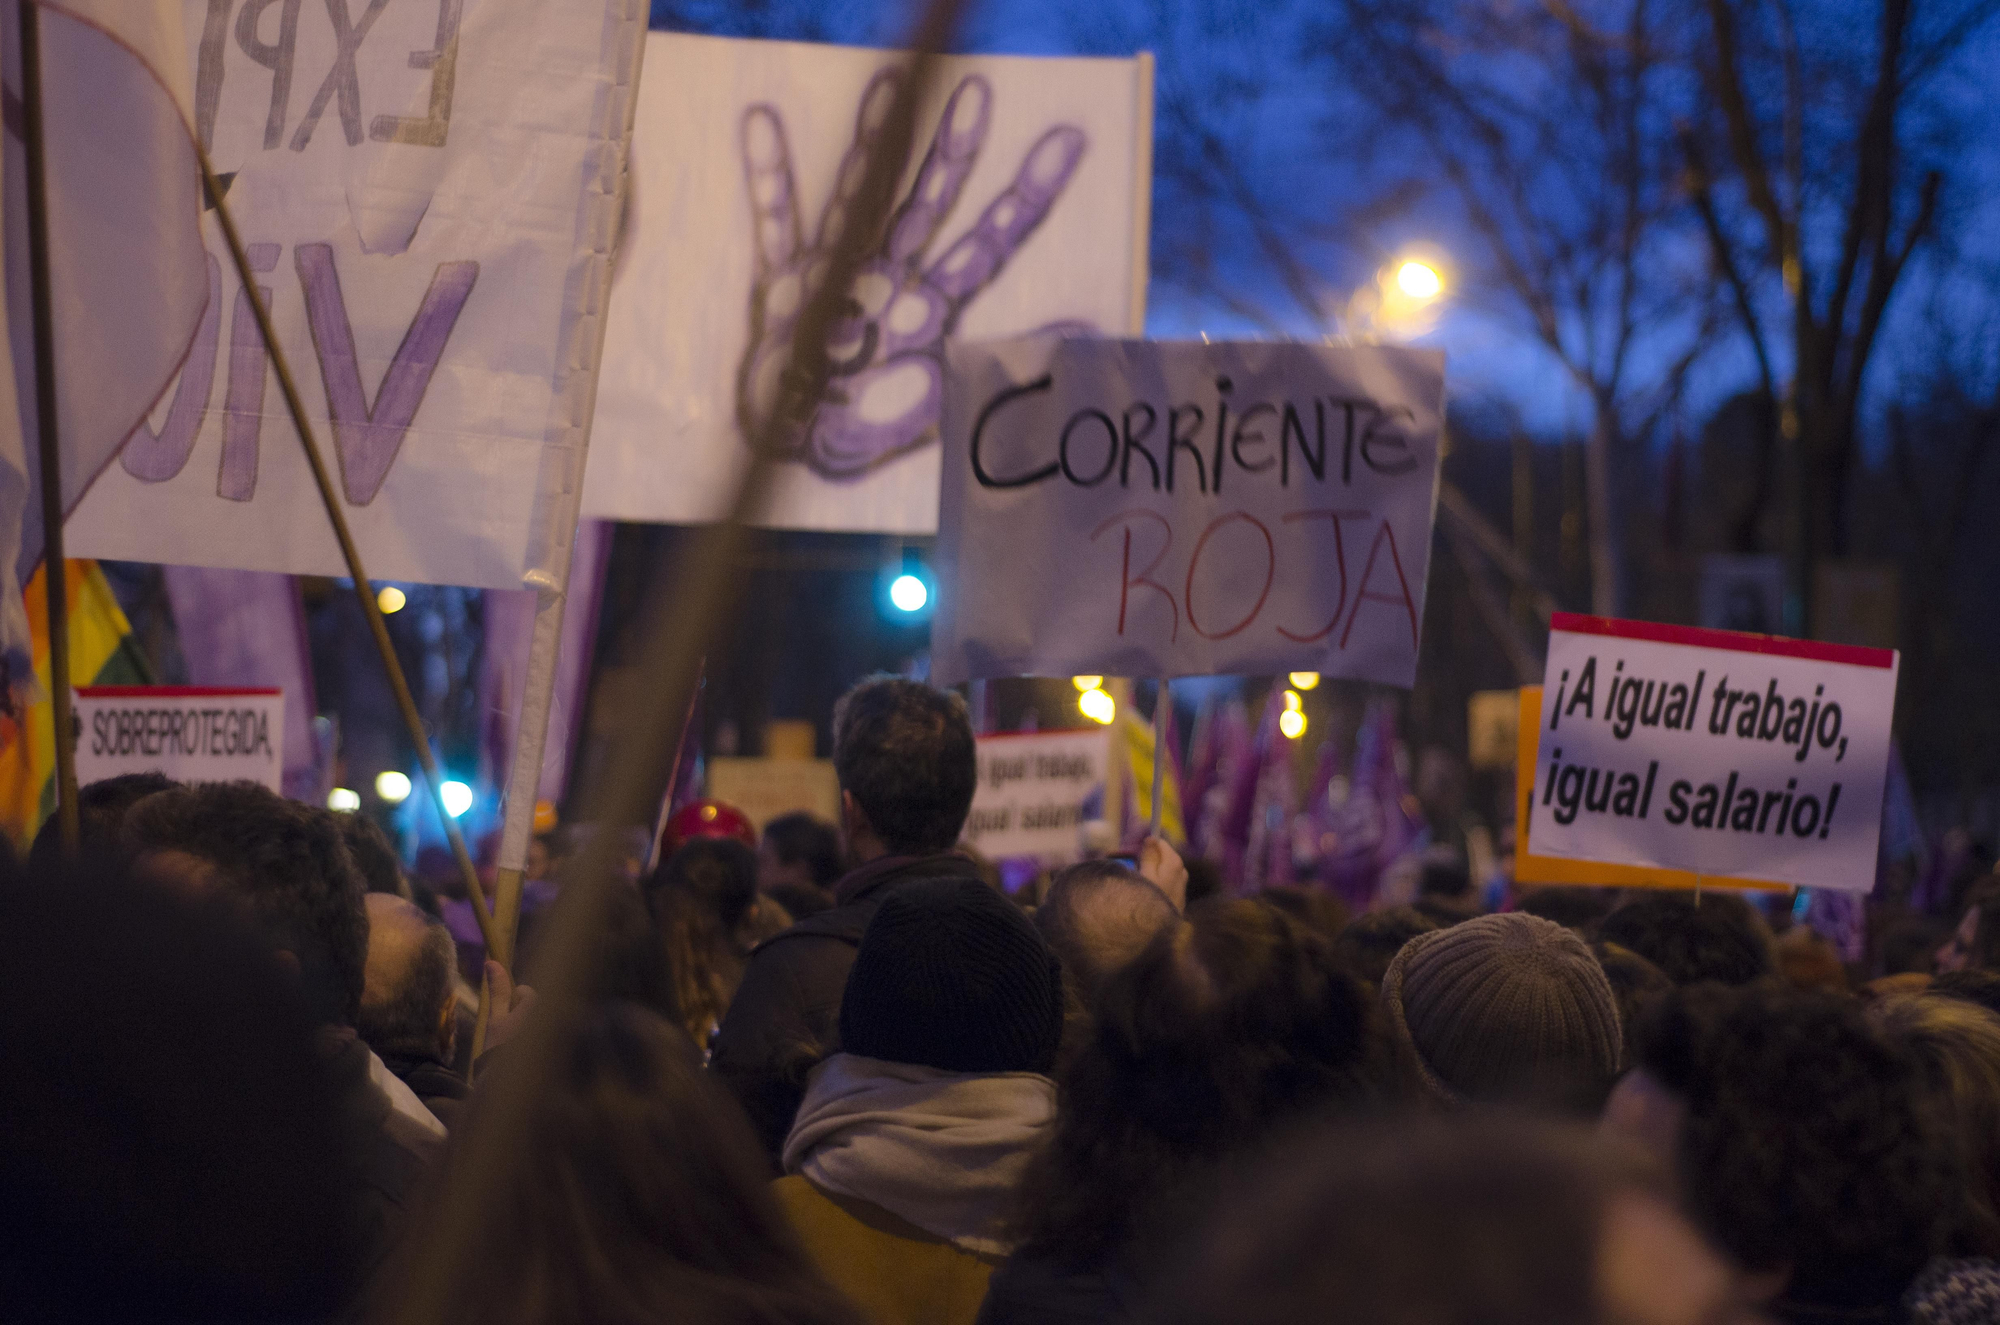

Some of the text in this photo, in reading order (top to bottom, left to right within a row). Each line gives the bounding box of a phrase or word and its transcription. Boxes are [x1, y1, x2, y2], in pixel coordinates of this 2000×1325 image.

[1091, 508, 1419, 650] ROJA
[1550, 656, 1849, 763] ¡A igual trabajo,
[1542, 747, 1660, 825] igual
[1664, 771, 1842, 840] salario!
